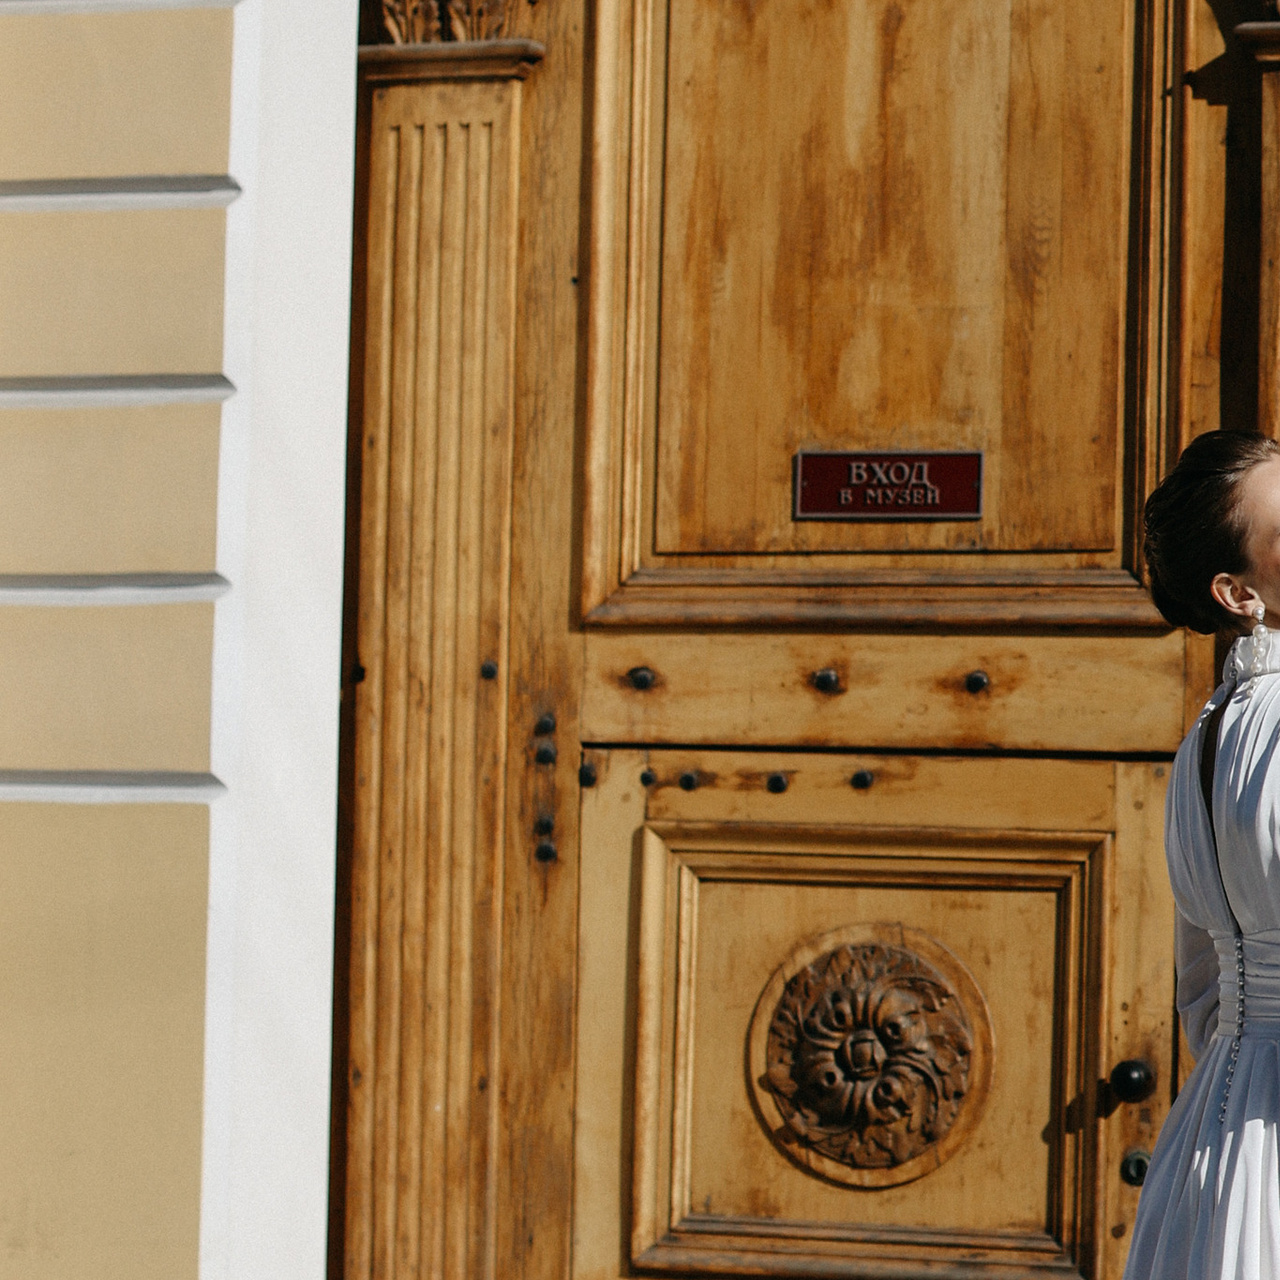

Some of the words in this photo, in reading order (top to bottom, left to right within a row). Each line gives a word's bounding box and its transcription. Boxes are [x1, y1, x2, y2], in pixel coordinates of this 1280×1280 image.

[850, 462, 935, 488] ВХОД
[840, 489, 853, 504] В
[866, 488, 940, 504] МУЗЕЙ
